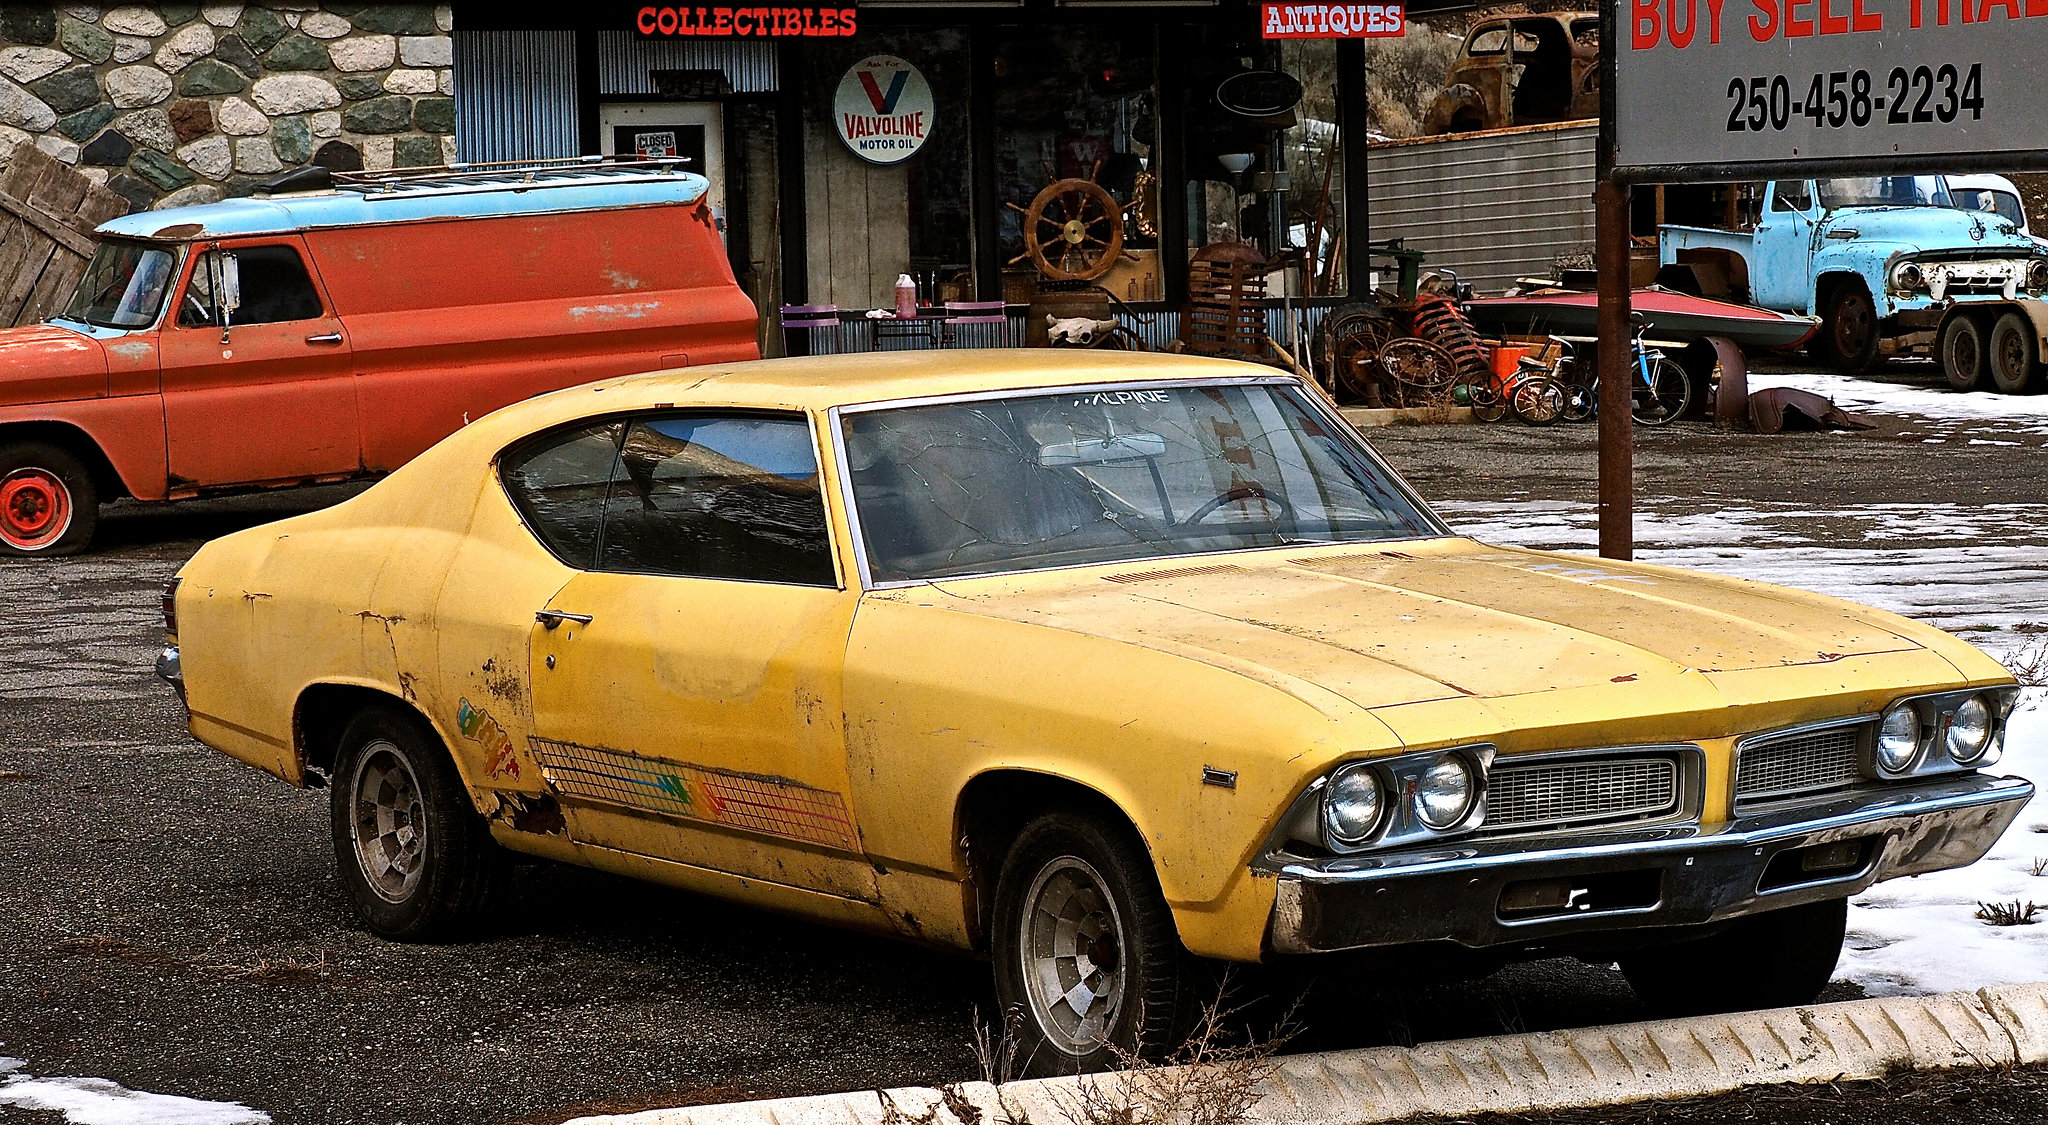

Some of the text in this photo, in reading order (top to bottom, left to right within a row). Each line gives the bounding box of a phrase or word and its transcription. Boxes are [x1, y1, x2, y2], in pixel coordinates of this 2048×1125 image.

[637, 7, 857, 37] COLLECTIBLES
[1266, 5, 1401, 36] ANTIQUES
[1632, 0, 1725, 51] BUY
[1726, 62, 1985, 132] 250-458-2234
[844, 110, 924, 140] VALVOLINE
[639, 135, 673, 149] CLOSED
[859, 138, 915, 150] MOTOR OIL
